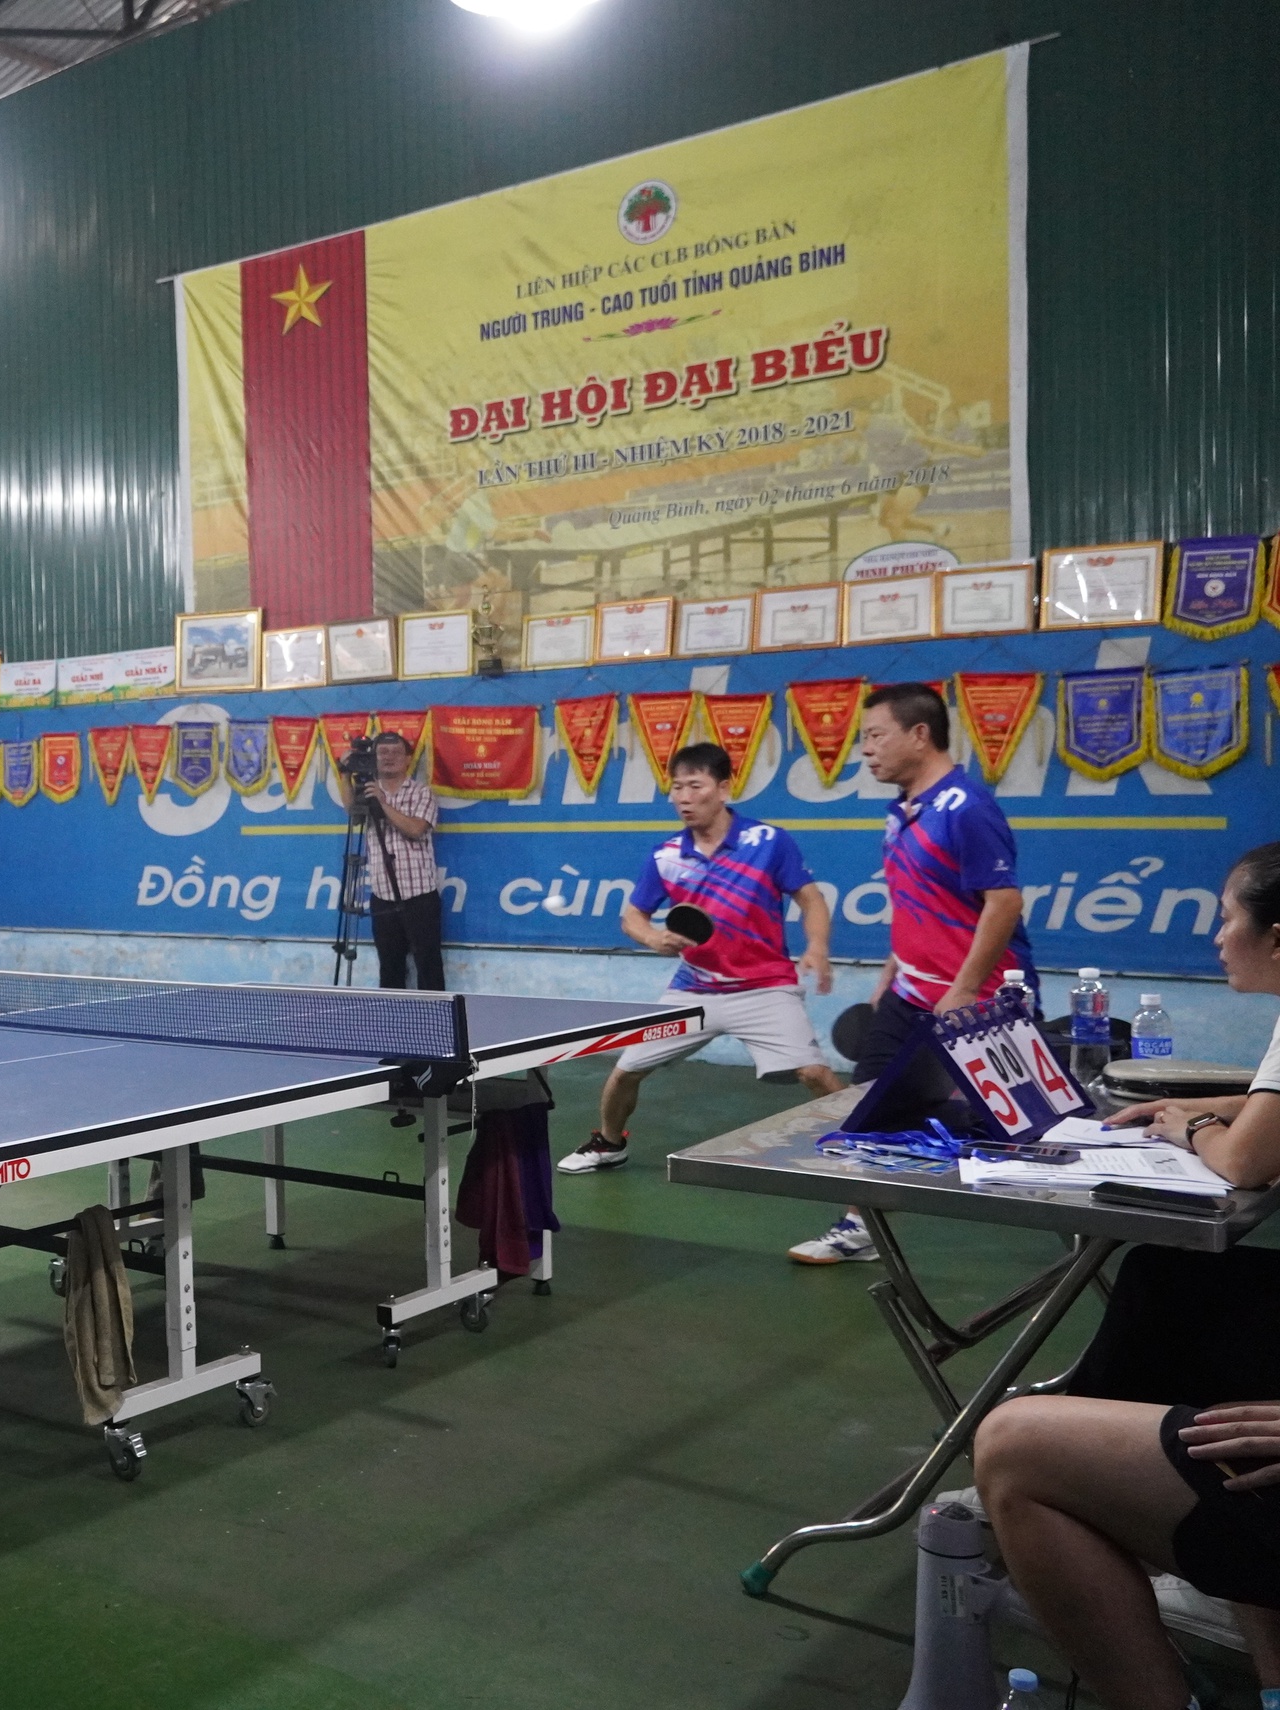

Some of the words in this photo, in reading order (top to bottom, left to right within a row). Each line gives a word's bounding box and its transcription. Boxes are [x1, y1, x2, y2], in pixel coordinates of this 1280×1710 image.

[480, 311, 527, 341] NGƯỜI
[531, 302, 584, 330] TRUNG
[601, 291, 634, 315] CAO
[639, 274, 677, 307] TUỔI
[683, 269, 723, 298] TỈNH
[729, 254, 792, 289] QUẢNG
[799, 244, 846, 273] BÌNH
[516, 276, 556, 299] LIÊN
[561, 265, 603, 289] HIỆP
[607, 255, 645, 279] CÁC
[650, 247, 688, 269] CLB
[694, 233, 749, 259] BÓNG
[755, 220, 797, 245] BÀN
[448, 396, 527, 440] ĐẠI
[540, 375, 629, 424] HỘI
[644, 357, 734, 407] ĐẠI
[750, 321, 884, 386] BIỂU
[478, 460, 519, 487] LẦN
[525, 454, 567, 479] THỨ
[573, 453, 596, 474] III
[614, 436, 691, 467] NHIỆM
[697, 427, 732, 453] KỲ
[737, 421, 784, 447] 2018
[805, 410, 852, 437] 2021
[758, 489, 778, 506] 02
[840, 479, 852, 495] 6
[905, 464, 951, 488] 2018
[136, 855, 281, 921] Đồng
[305, 866, 467, 914] hh
[499, 864, 668, 925] cùn
[1021, 856, 1218, 935] riển
[643, 1026, 662, 1041] 6825
[663, 1023, 680, 1038] ECO
[965, 1057, 1019, 1126] 5
[1031, 1039, 1074, 1102] 4
